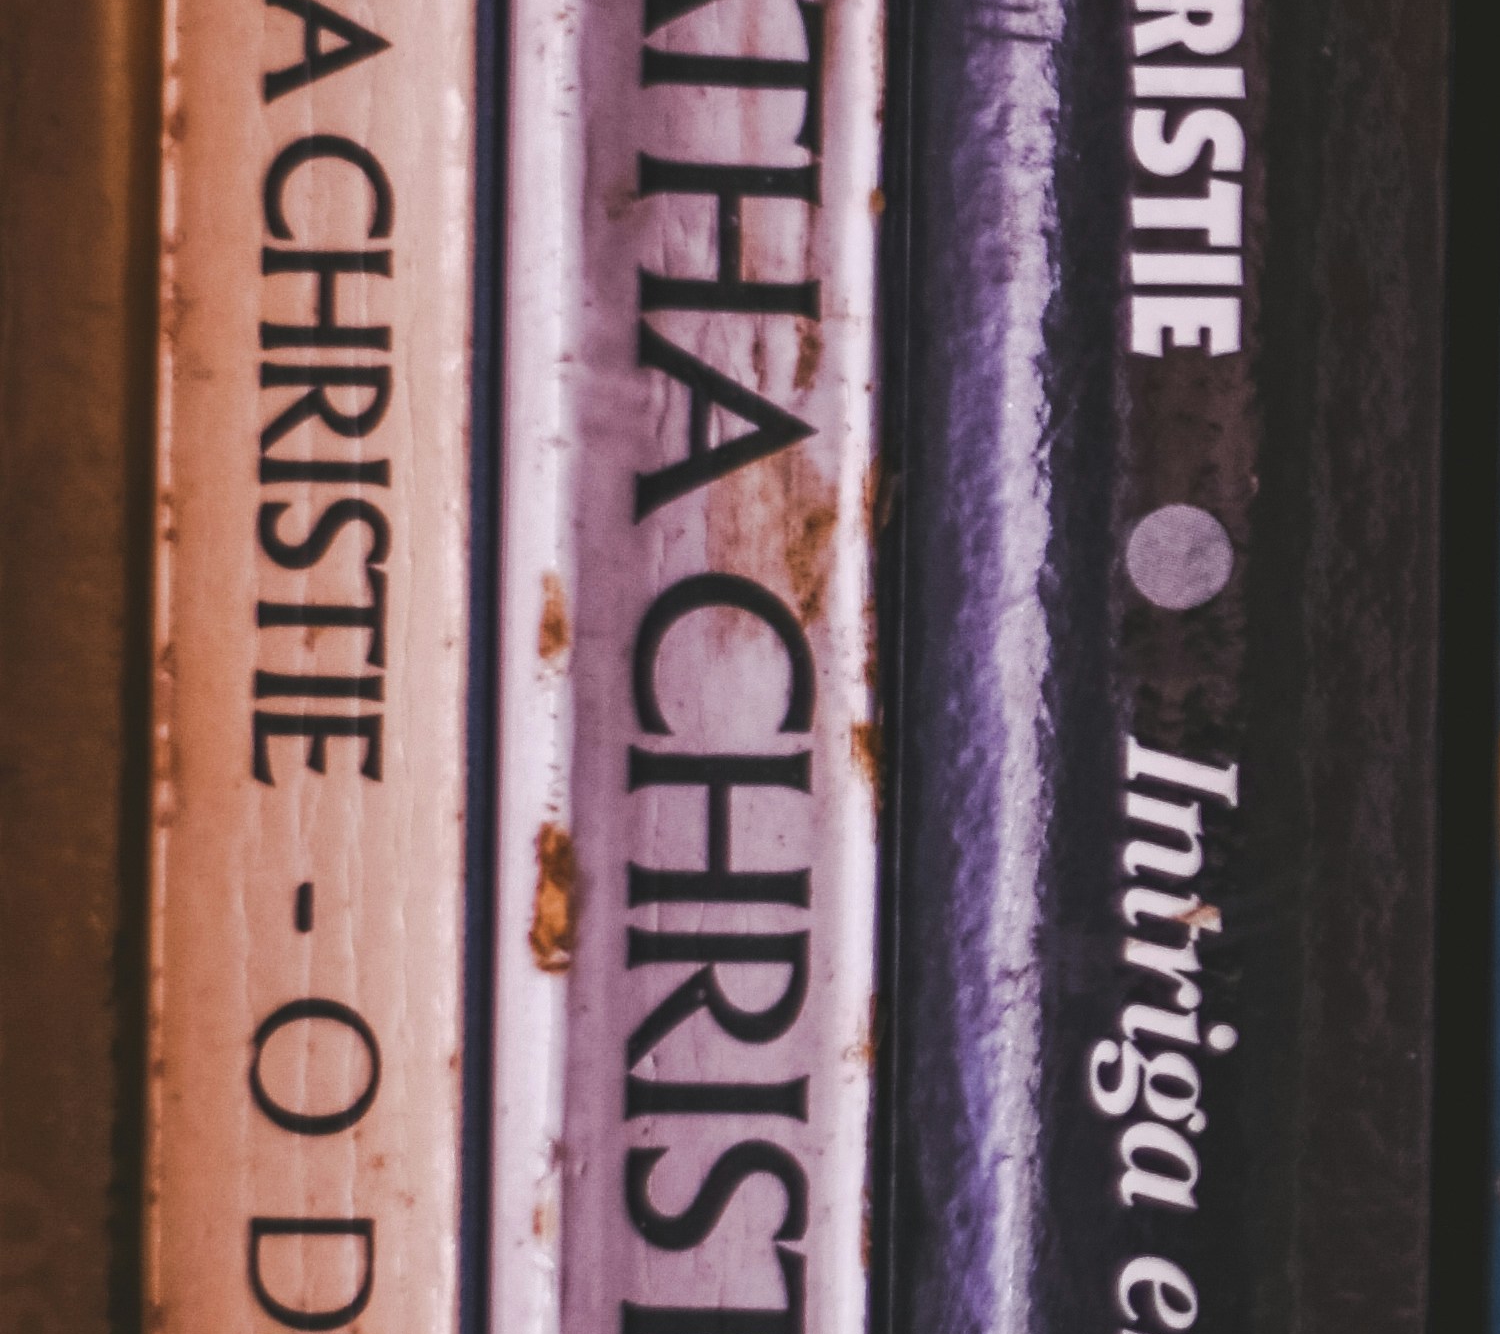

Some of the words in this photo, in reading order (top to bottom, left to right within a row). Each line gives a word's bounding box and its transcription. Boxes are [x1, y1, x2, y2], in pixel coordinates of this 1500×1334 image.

[254, 135, 395, 785] CHRISTIE
[246, 997, 382, 1136] O
[1089, 739, 1239, 1212] Intriga
